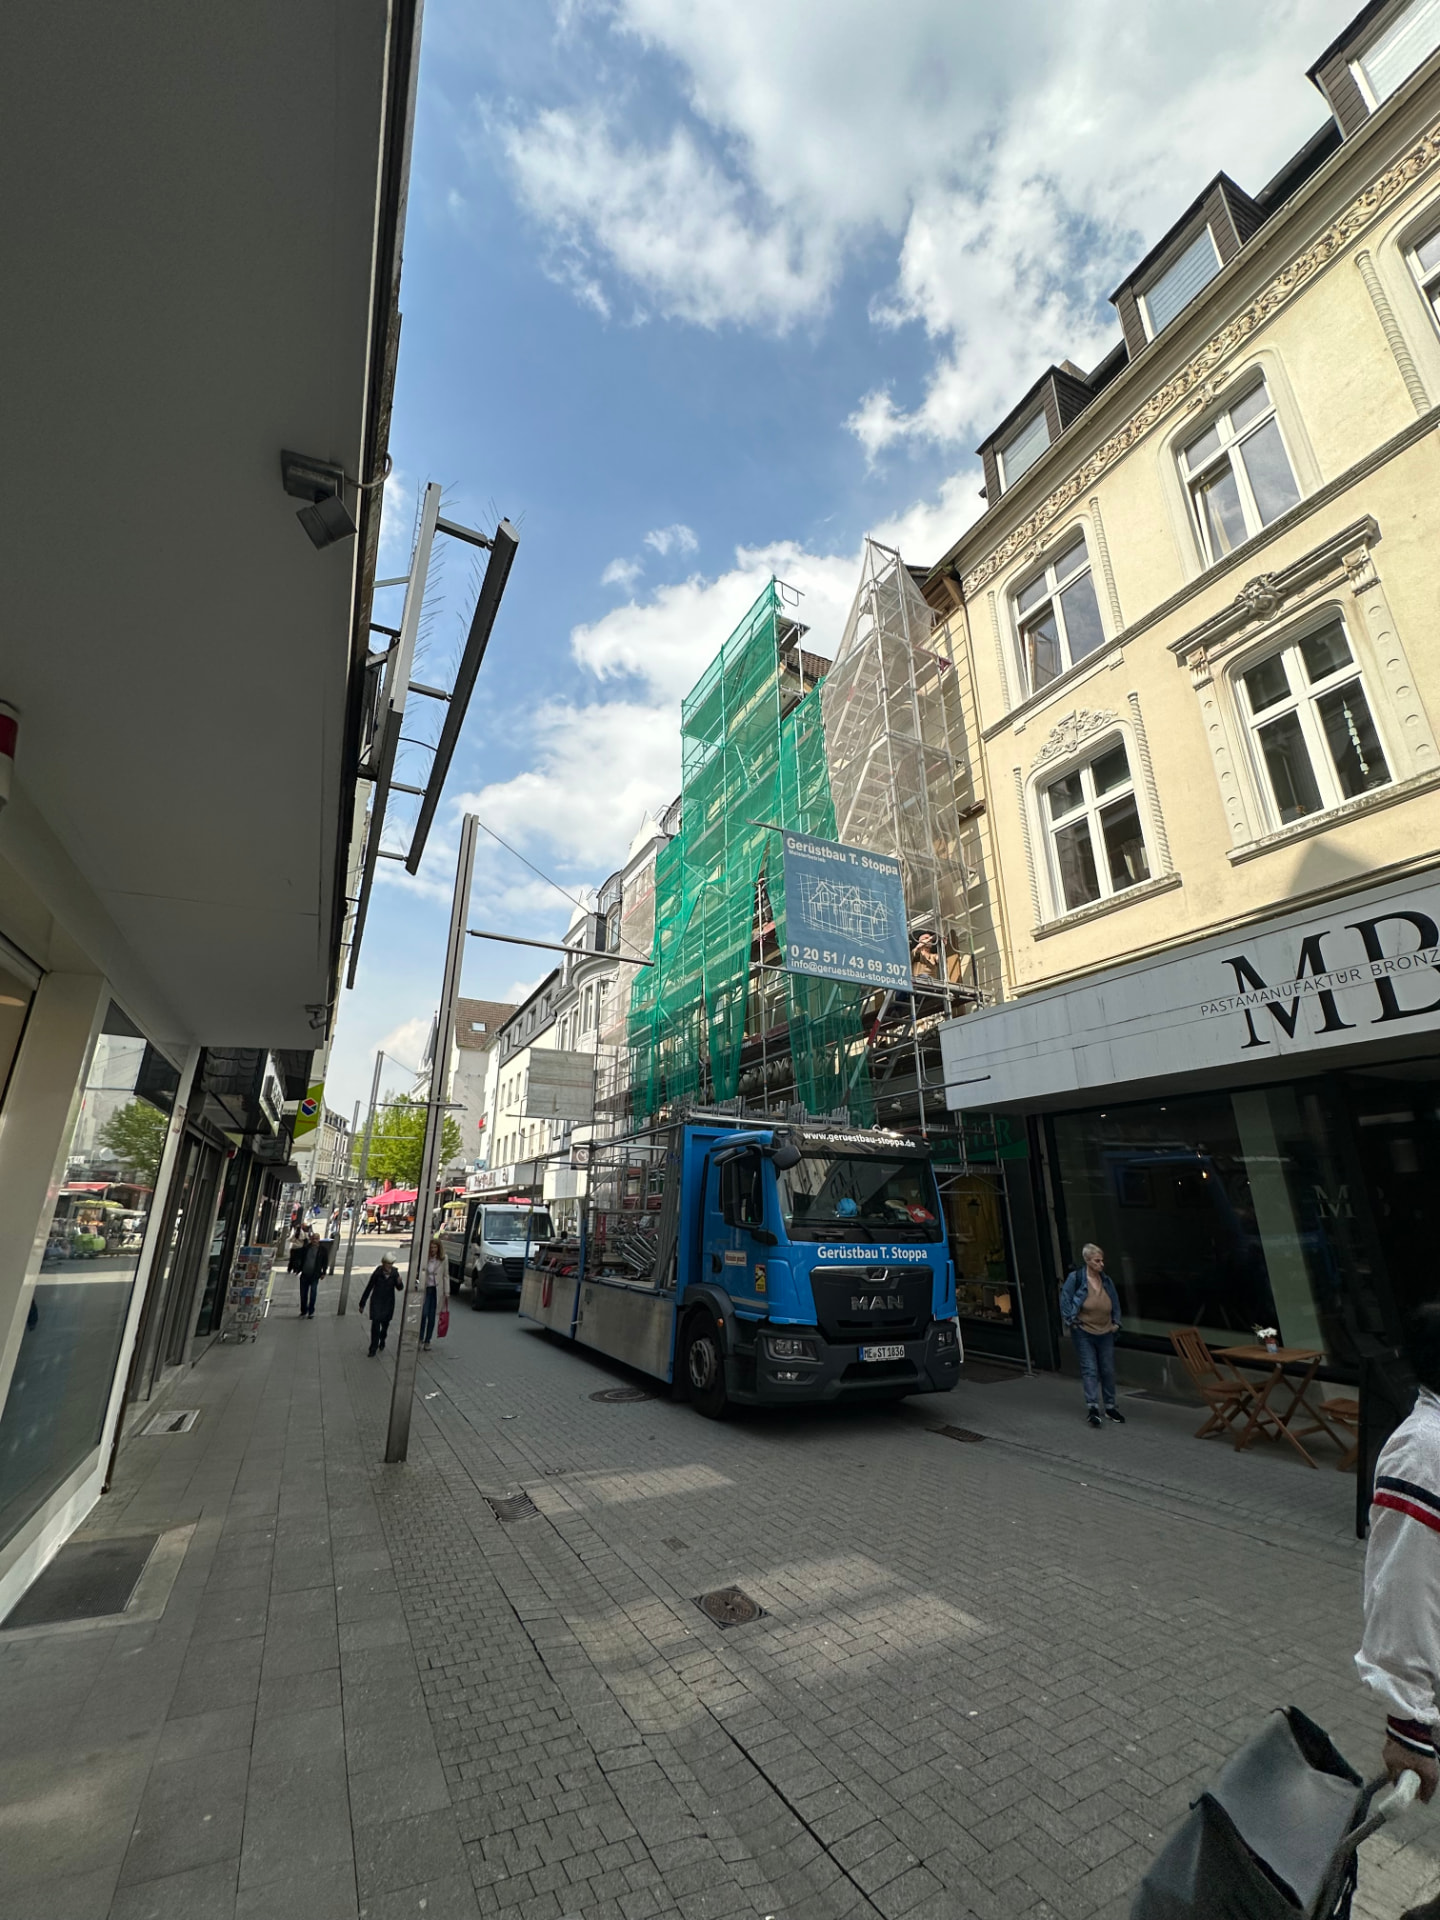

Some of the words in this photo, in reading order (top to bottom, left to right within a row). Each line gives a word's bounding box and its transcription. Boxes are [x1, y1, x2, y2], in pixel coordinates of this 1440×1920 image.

[786, 837, 847, 863] Gerüstbau
[848, 853, 859, 866] T.
[861, 857, 898, 877] Stoppa
[790, 944, 800, 958] 0
[803, 947, 819, 961] 20
[823, 950, 837, 964] 51
[849, 955, 864, 969] 43
[867, 958, 883, 973] 69
[886, 962, 907, 977] 307
[790, 958, 908, 987] info@geruestbau-stoppa.de
[1200, 967, 1362, 1017] PASTAMANUFAKTUR
[802, 1132, 916, 1148] www.geruestbau-stoppa.de
[817, 1245, 878, 1259] Gerüstbau
[880, 1246, 890, 1259] T.
[891, 1247, 928, 1262] Stoppa
[850, 1295, 904, 1311] MAN
[864, 1348, 873, 1359] ME
[877, 1347, 886, 1358] ST
[886, 1346, 904, 1357] 1836
